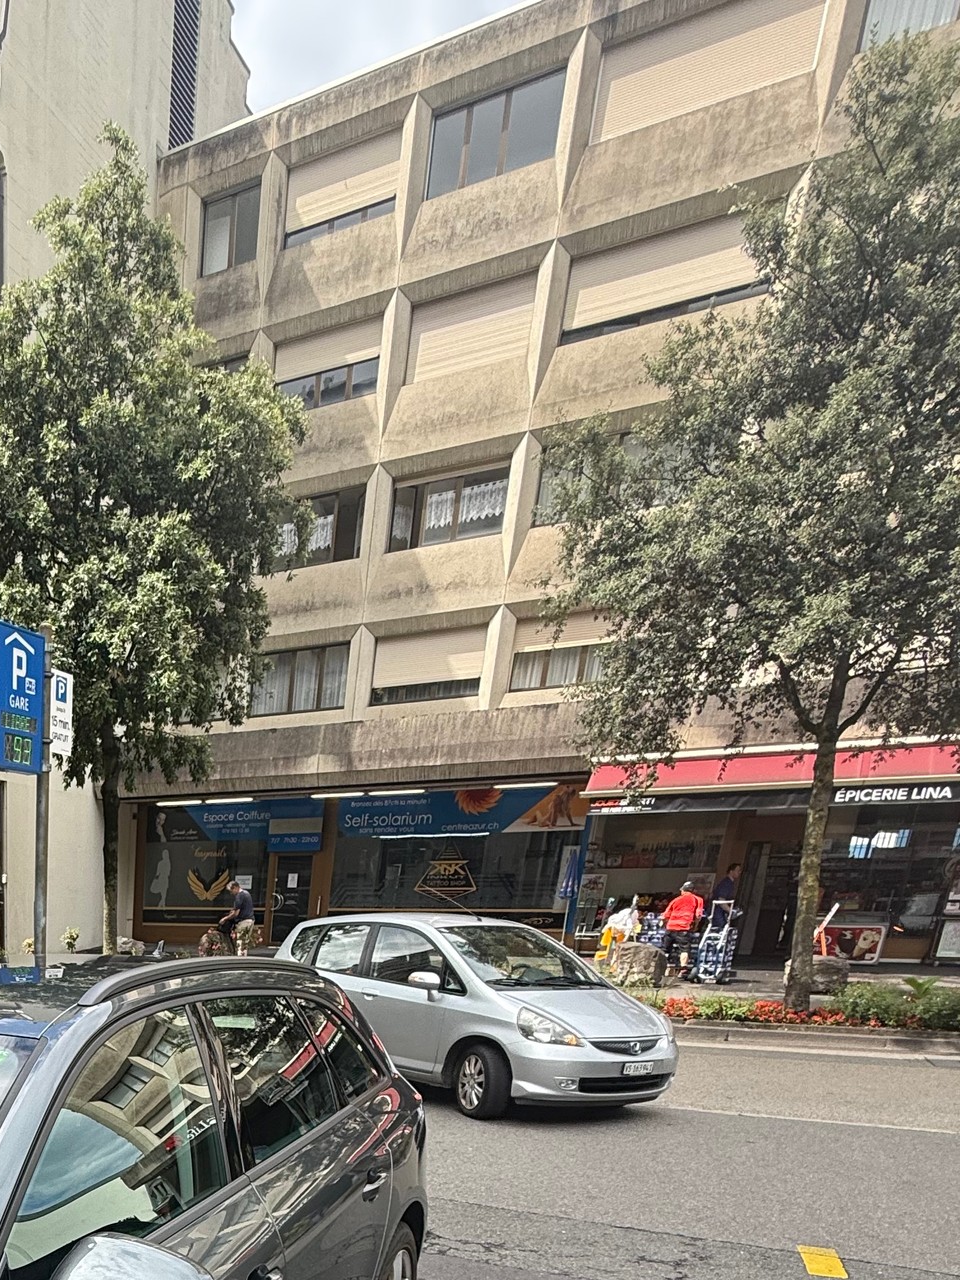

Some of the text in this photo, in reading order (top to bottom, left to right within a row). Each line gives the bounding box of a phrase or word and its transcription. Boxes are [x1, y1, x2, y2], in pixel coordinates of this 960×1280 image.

[12, 647, 27, 690] P
[58, 682, 65, 699] P
[9, 694, 29, 711] GARE
[51, 715, 58, 727] 15
[834, 786, 952, 802] ÉPICERIE LINA
[203, 811, 271, 823] Espace Coiffure
[344, 812, 433, 828] Self-solarium
[441, 822, 500, 832] centreazur.ch
